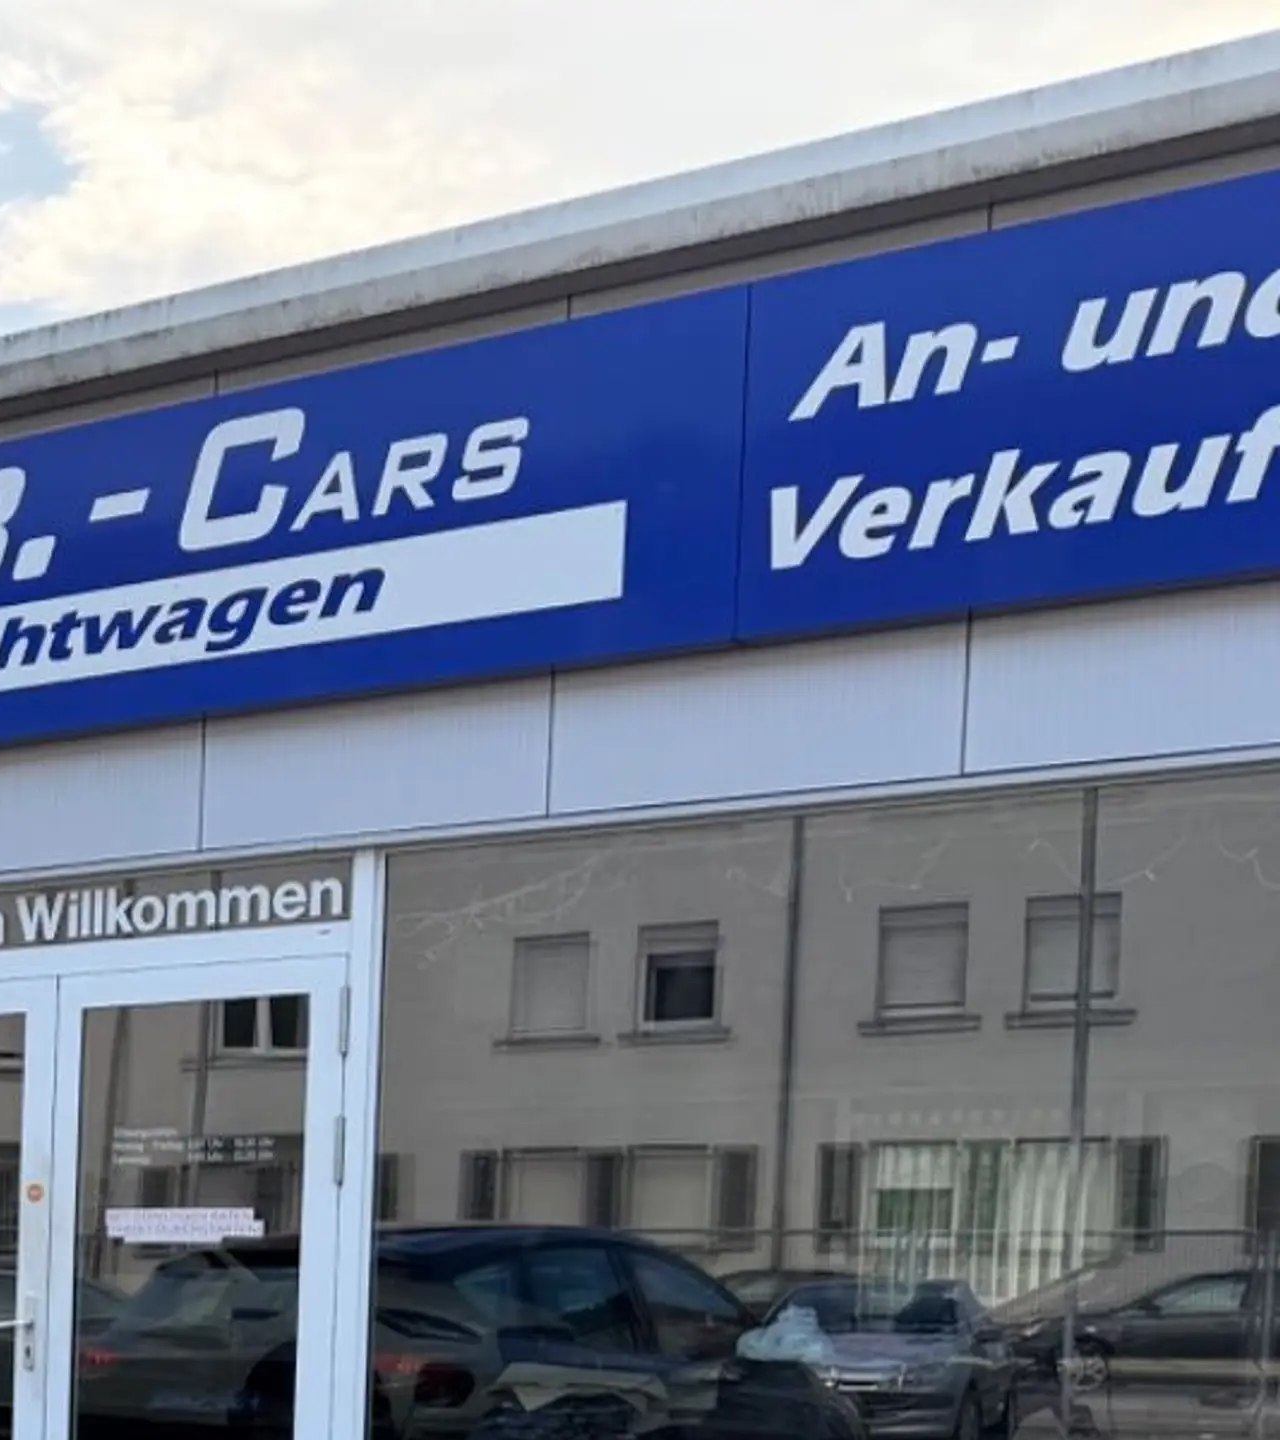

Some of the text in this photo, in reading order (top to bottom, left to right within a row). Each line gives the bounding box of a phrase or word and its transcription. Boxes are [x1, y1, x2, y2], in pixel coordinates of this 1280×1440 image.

[788, 321, 1019, 421] An-
[771, 405, 1280, 569] Verkauf
[16, 877, 343, 943] Willkommen
